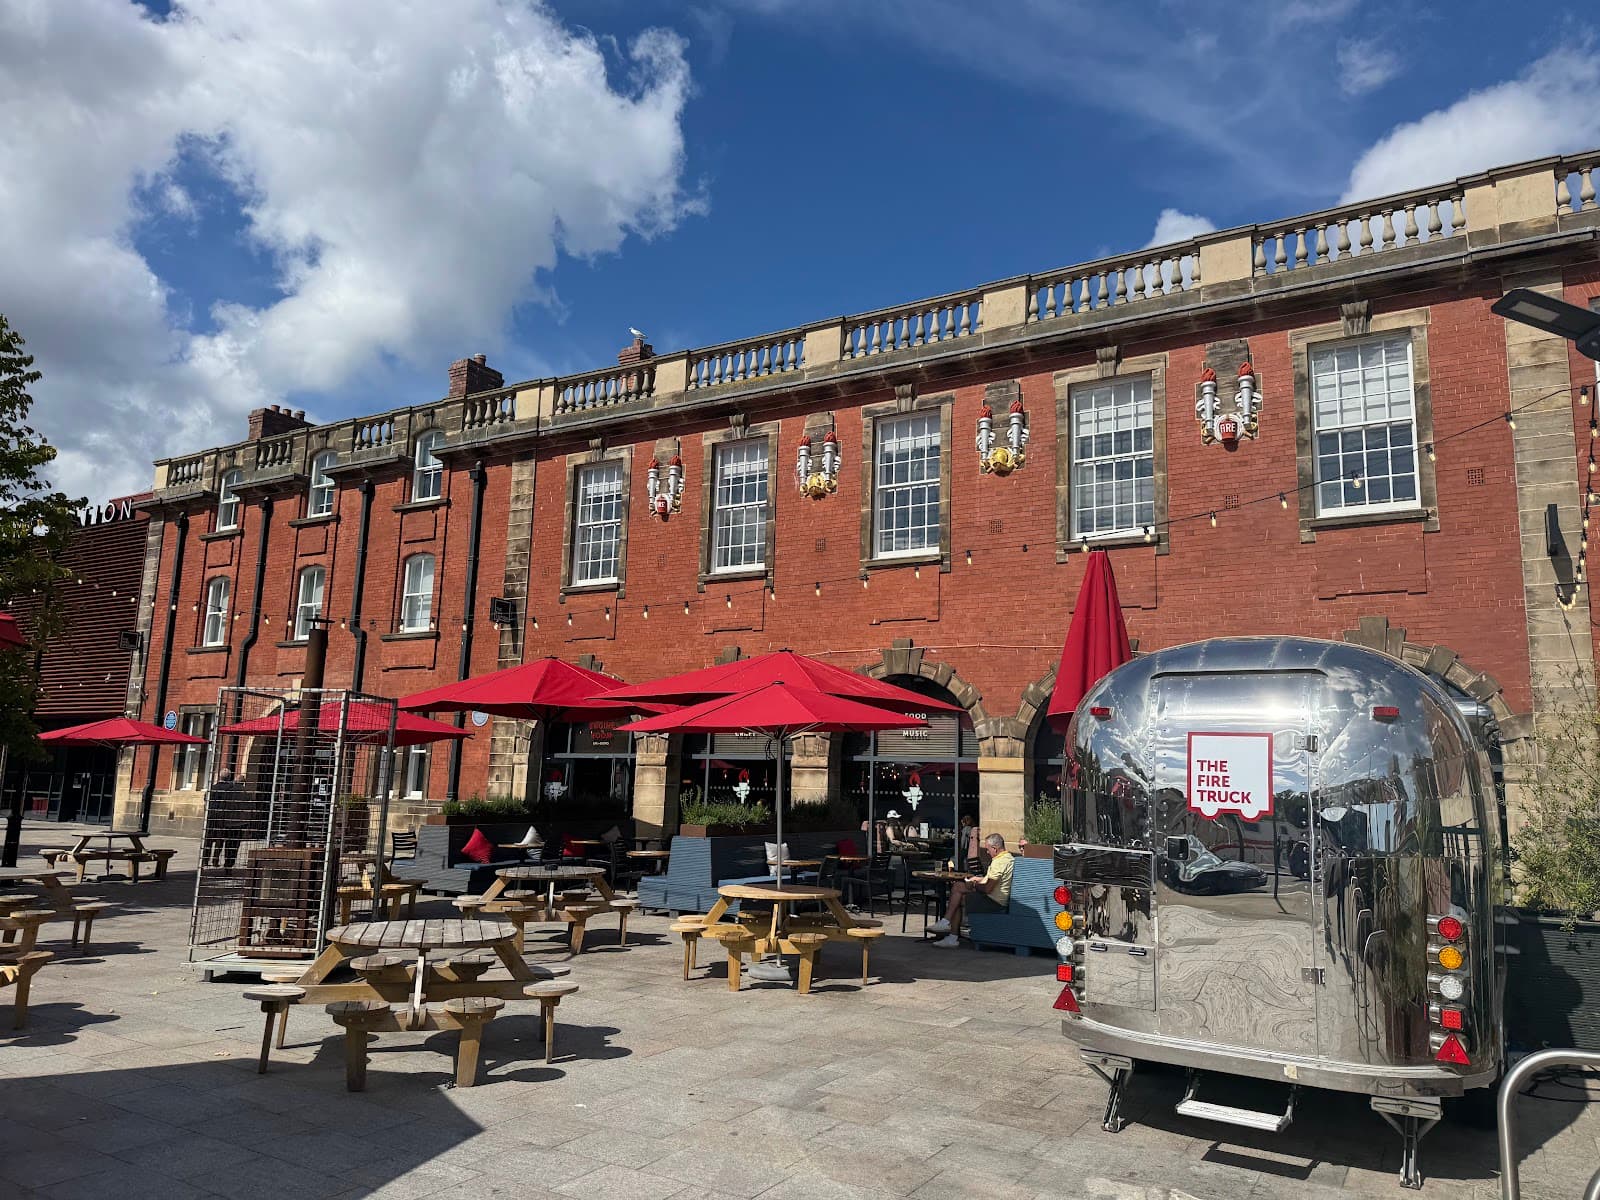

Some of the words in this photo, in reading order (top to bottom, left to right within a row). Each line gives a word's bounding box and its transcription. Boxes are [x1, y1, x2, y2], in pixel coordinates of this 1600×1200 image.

[1196, 759, 1229, 773] THE
[1197, 774, 1231, 788] FIRE
[1196, 789, 1252, 804] TRUCK
